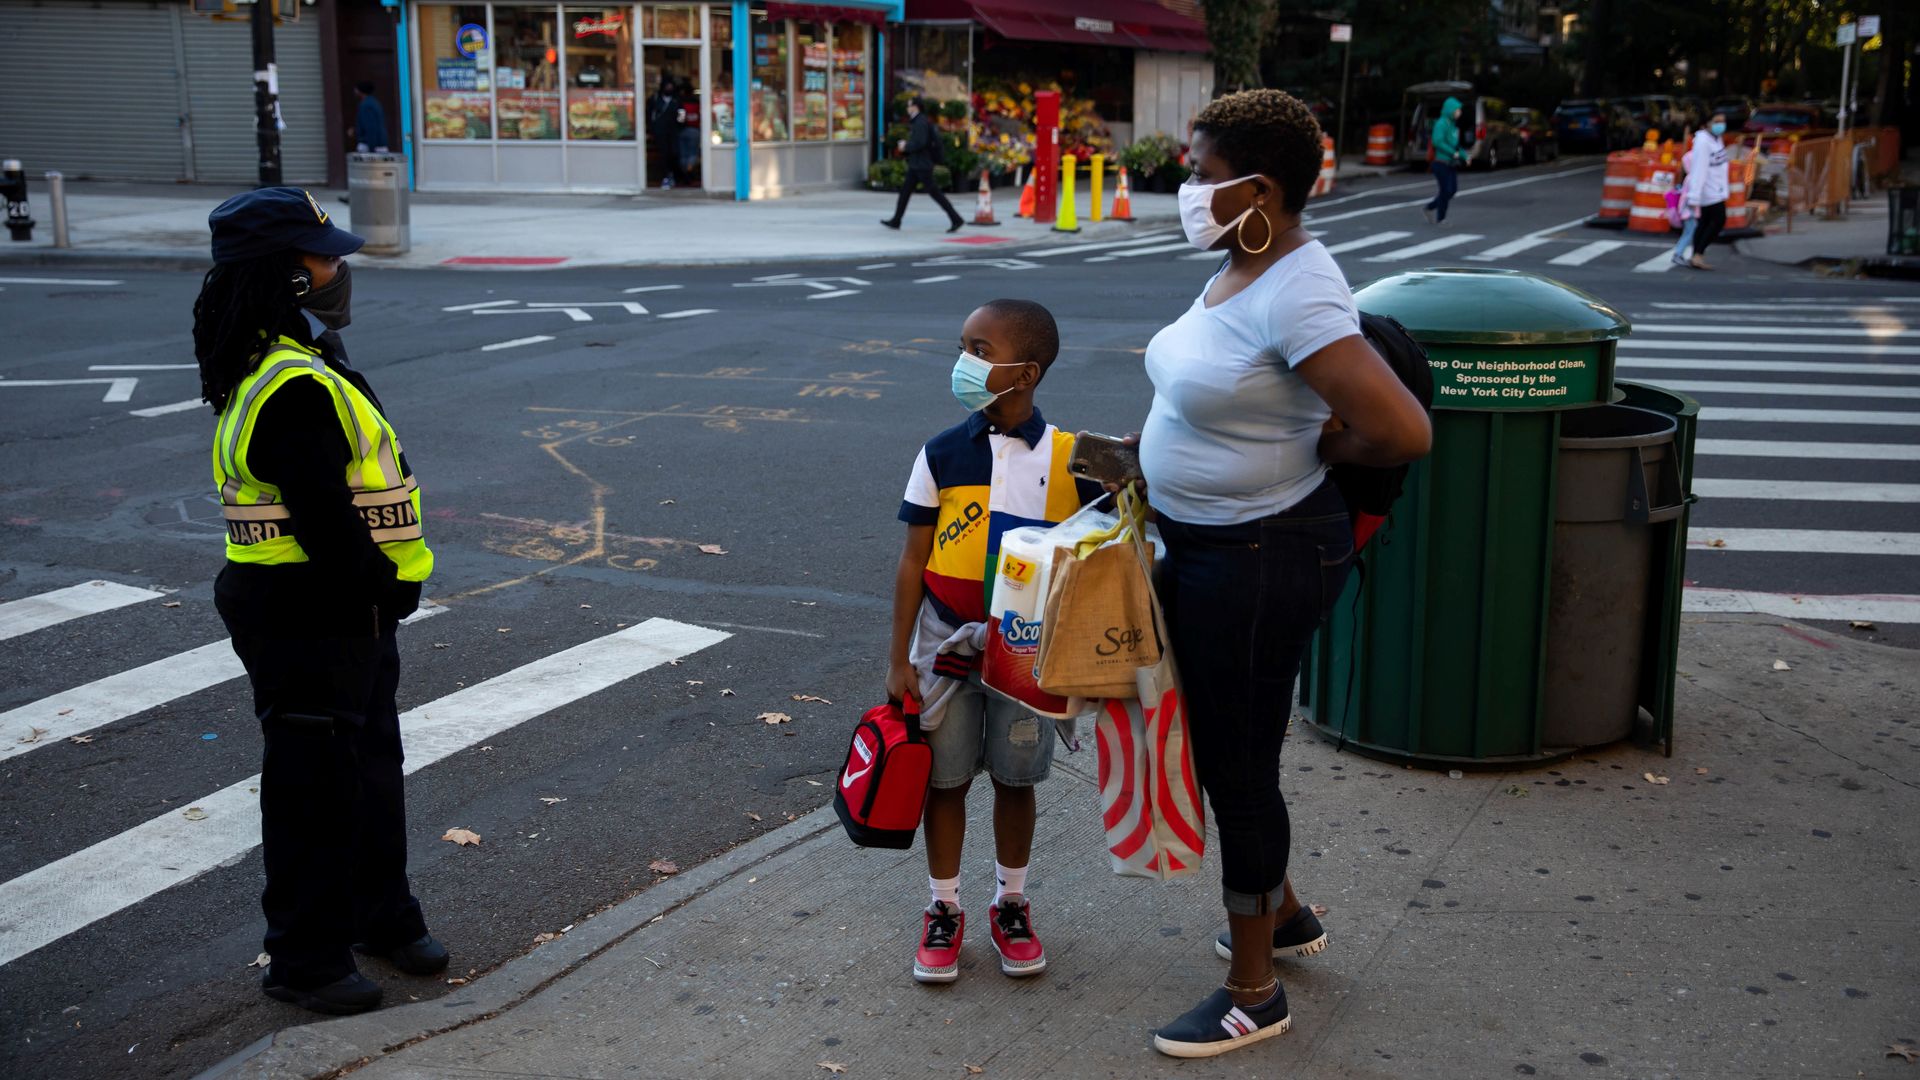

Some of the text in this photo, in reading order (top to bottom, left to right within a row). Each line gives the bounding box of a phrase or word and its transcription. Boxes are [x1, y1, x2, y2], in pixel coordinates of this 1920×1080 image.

[1428, 360, 1586, 372] eep Our Neighborhood Clean,
[1456, 373, 1556, 385] Sponsored by the
[1440, 386, 1567, 398] New York City Council
[364, 502, 418, 527] SSIN
[938, 501, 983, 551] POLO
[227, 522, 280, 544] UARD
[954, 513, 990, 546] RALPH
[1016, 562, 1027, 576] 7
[1007, 616, 1041, 641] Sco
[1095, 624, 1144, 656] Saje
